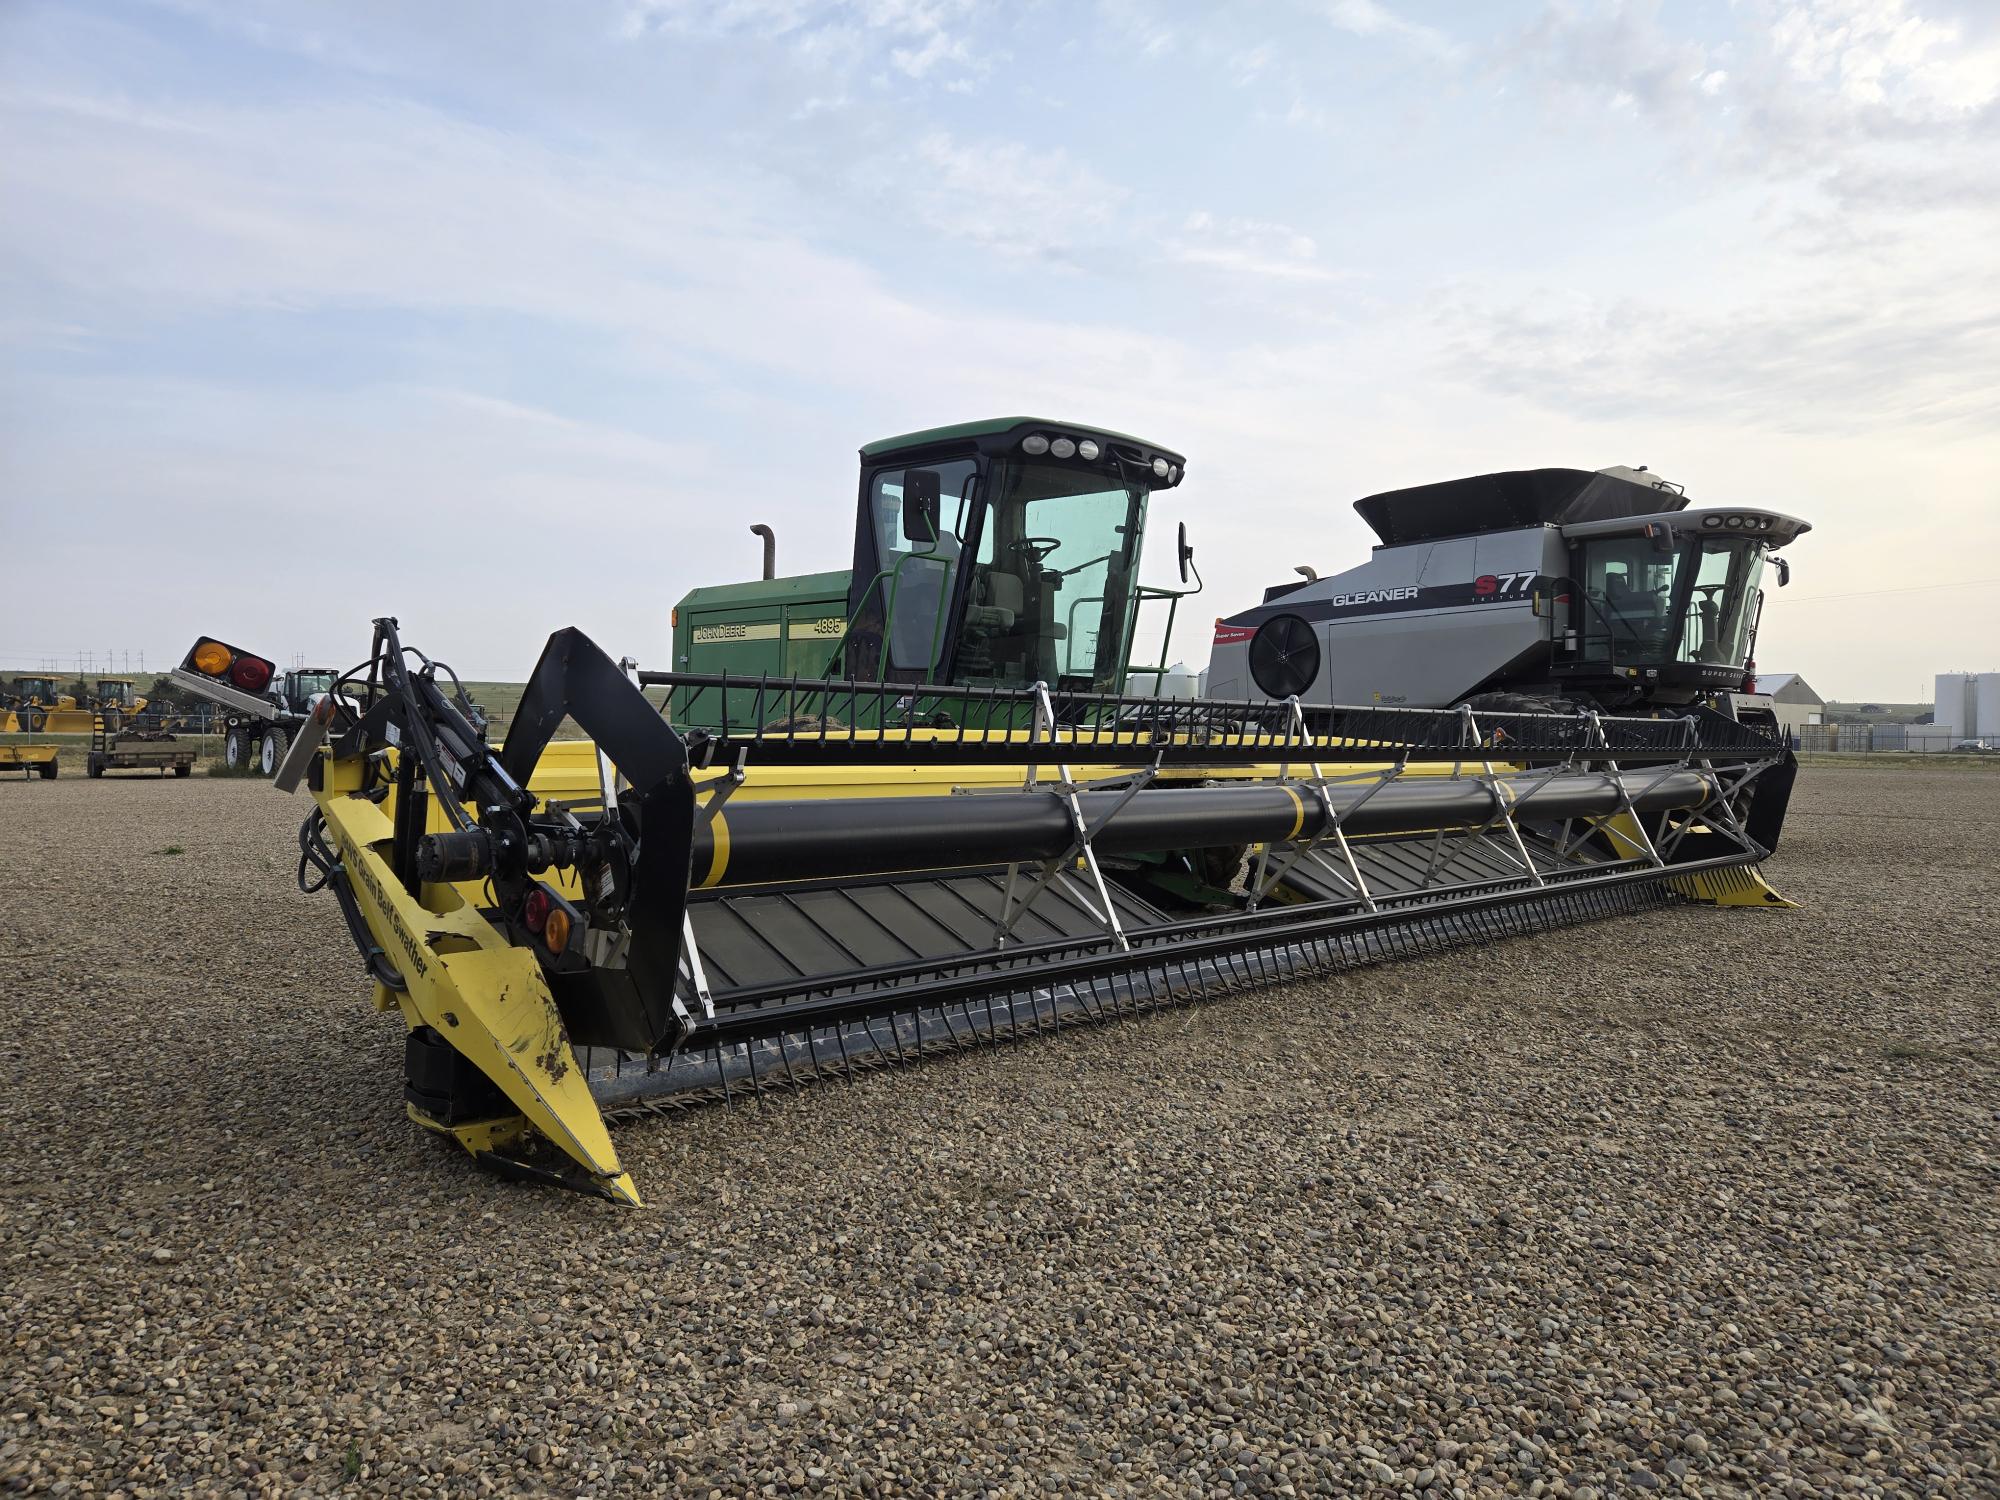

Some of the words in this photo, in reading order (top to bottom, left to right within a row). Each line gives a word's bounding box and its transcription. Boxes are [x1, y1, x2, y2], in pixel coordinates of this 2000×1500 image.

[1475, 570, 1537, 595] S77
[1333, 586, 1418, 607] GLEANER
[697, 625, 719, 640] JOHN
[719, 624, 747, 638] DEERE
[814, 618, 841, 634] 4895
[1701, 669, 1727, 677] SUPER
[358, 860, 377, 899] Grain
[377, 882, 393, 925] Belt
[393, 914, 428, 979] Swather
